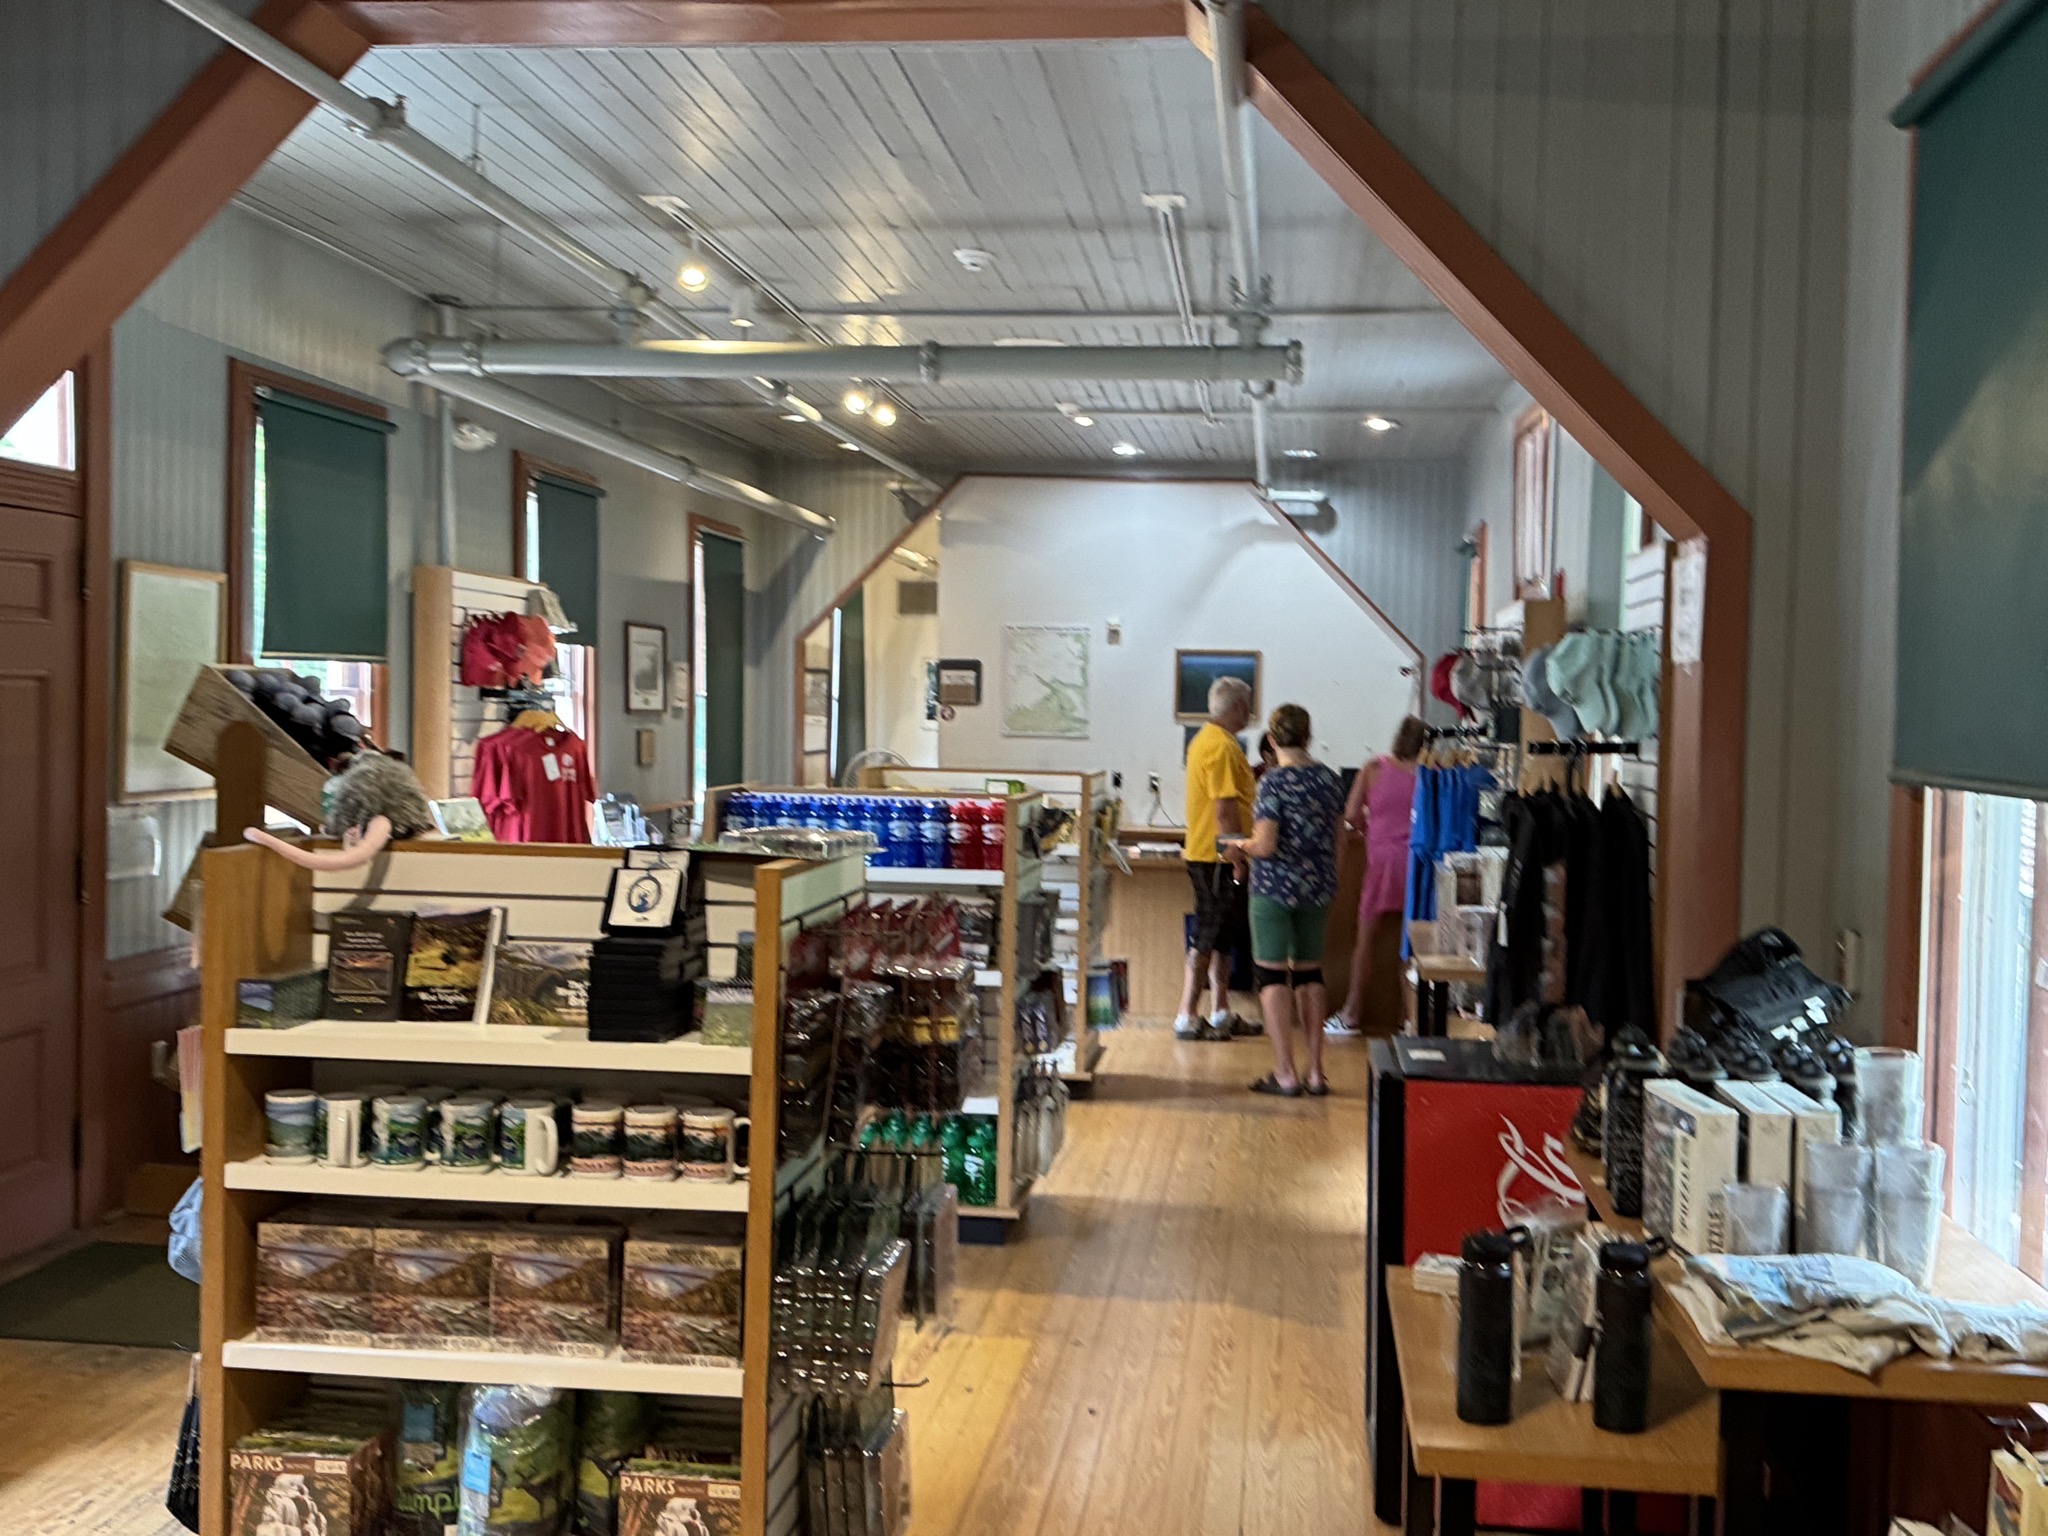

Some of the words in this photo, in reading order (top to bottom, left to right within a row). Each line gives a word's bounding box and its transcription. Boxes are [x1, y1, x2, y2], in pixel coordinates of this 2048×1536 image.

[1679, 1157, 1690, 1236] PUZZLE
[230, 1453, 285, 1472] PARKS
[620, 1475, 676, 1496] PARKS
